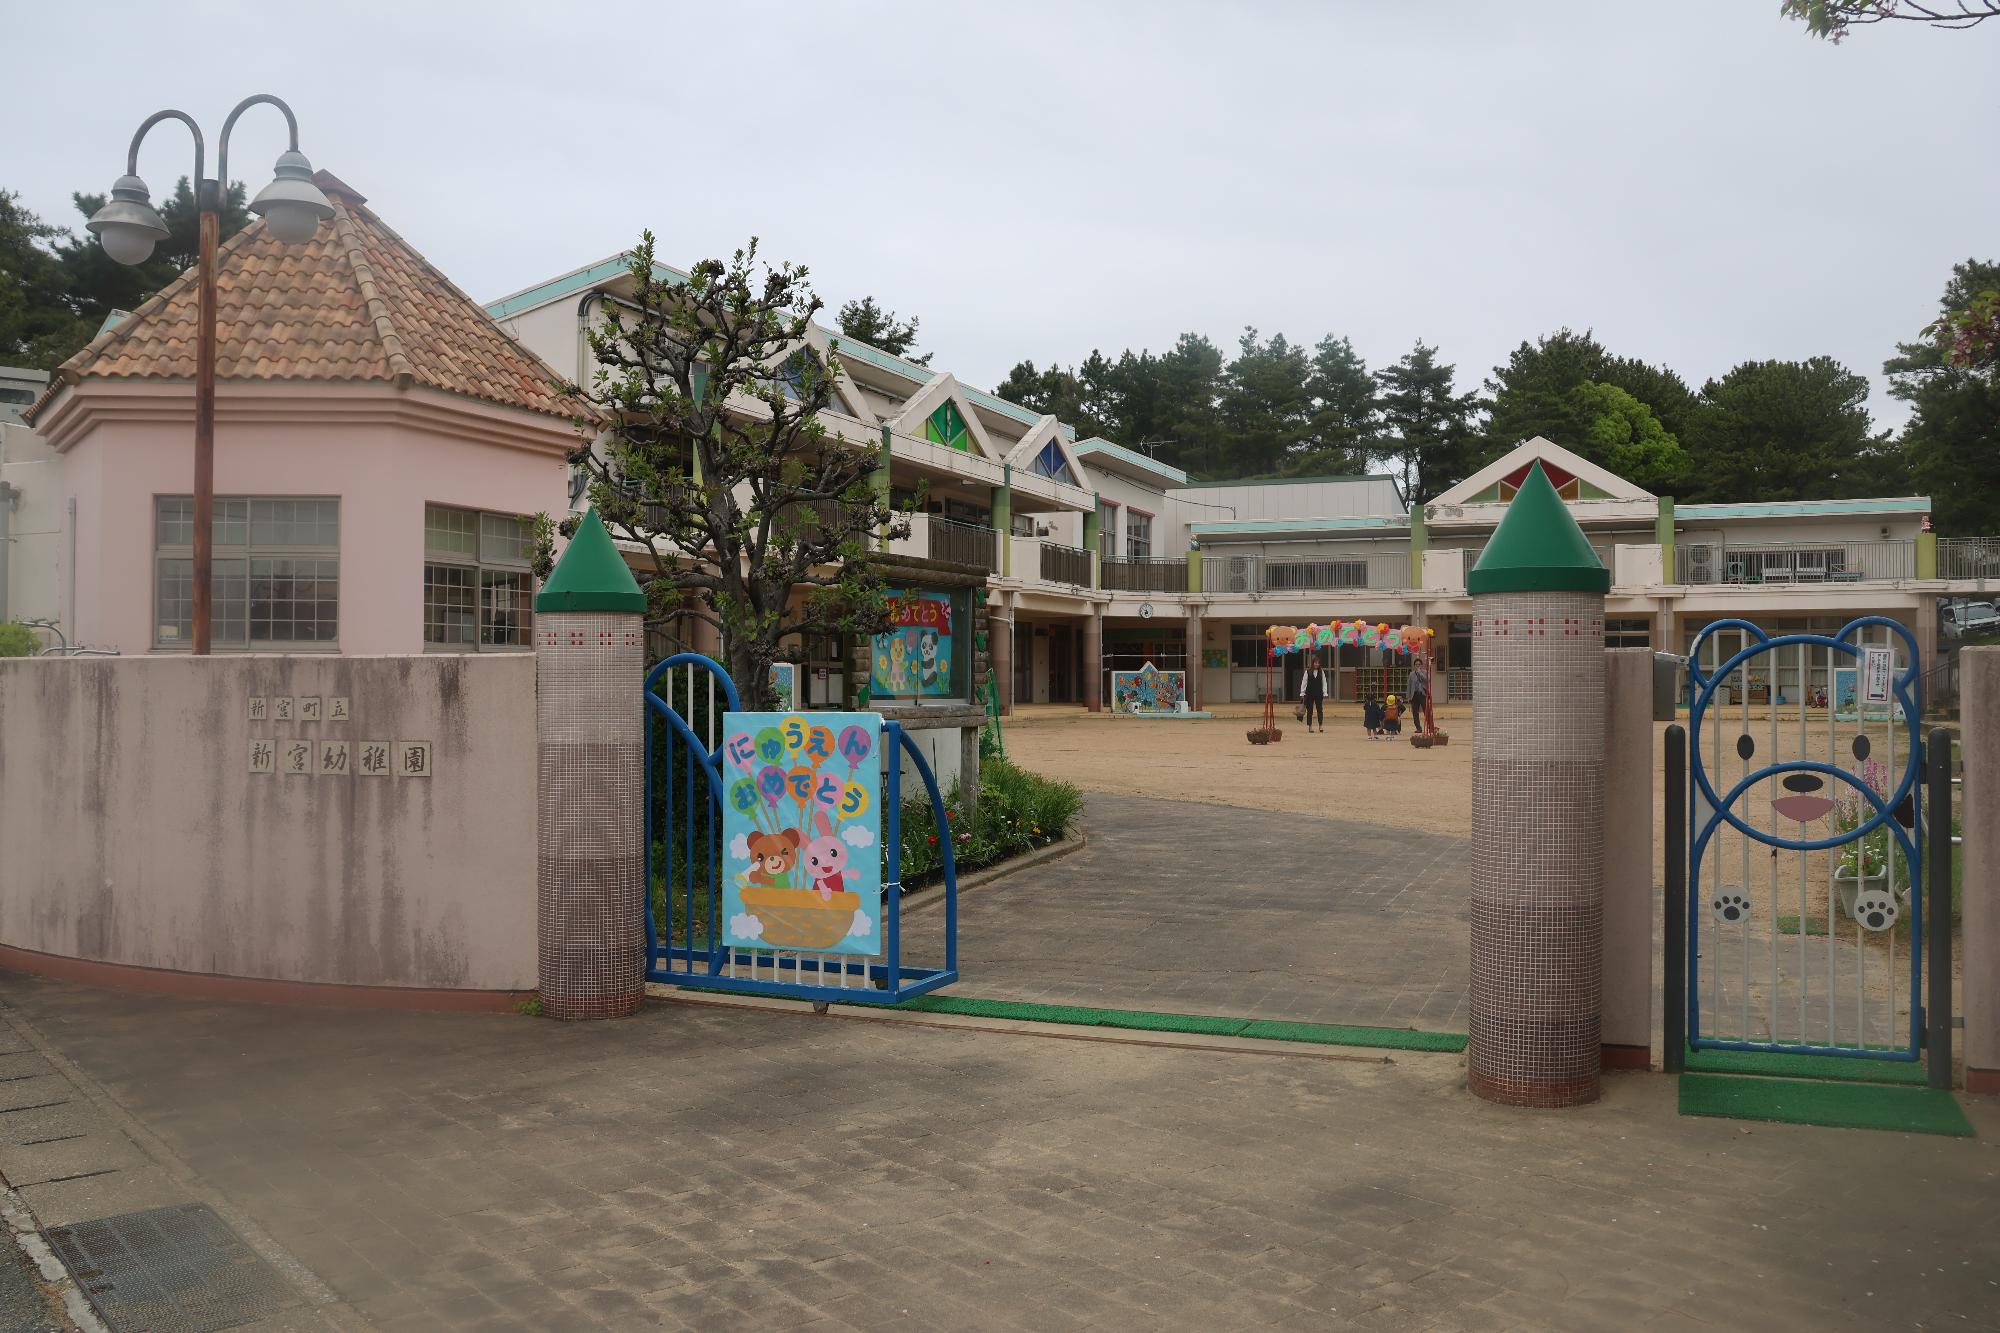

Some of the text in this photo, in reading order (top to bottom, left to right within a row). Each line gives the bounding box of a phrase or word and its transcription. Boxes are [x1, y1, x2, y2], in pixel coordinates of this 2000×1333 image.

[250, 700, 346, 718] 新宮町立
[251, 743, 425, 773] 新宮幼稚園
[729, 722, 867, 764] にゅうえん
[735, 774, 862, 813] おめでとう
